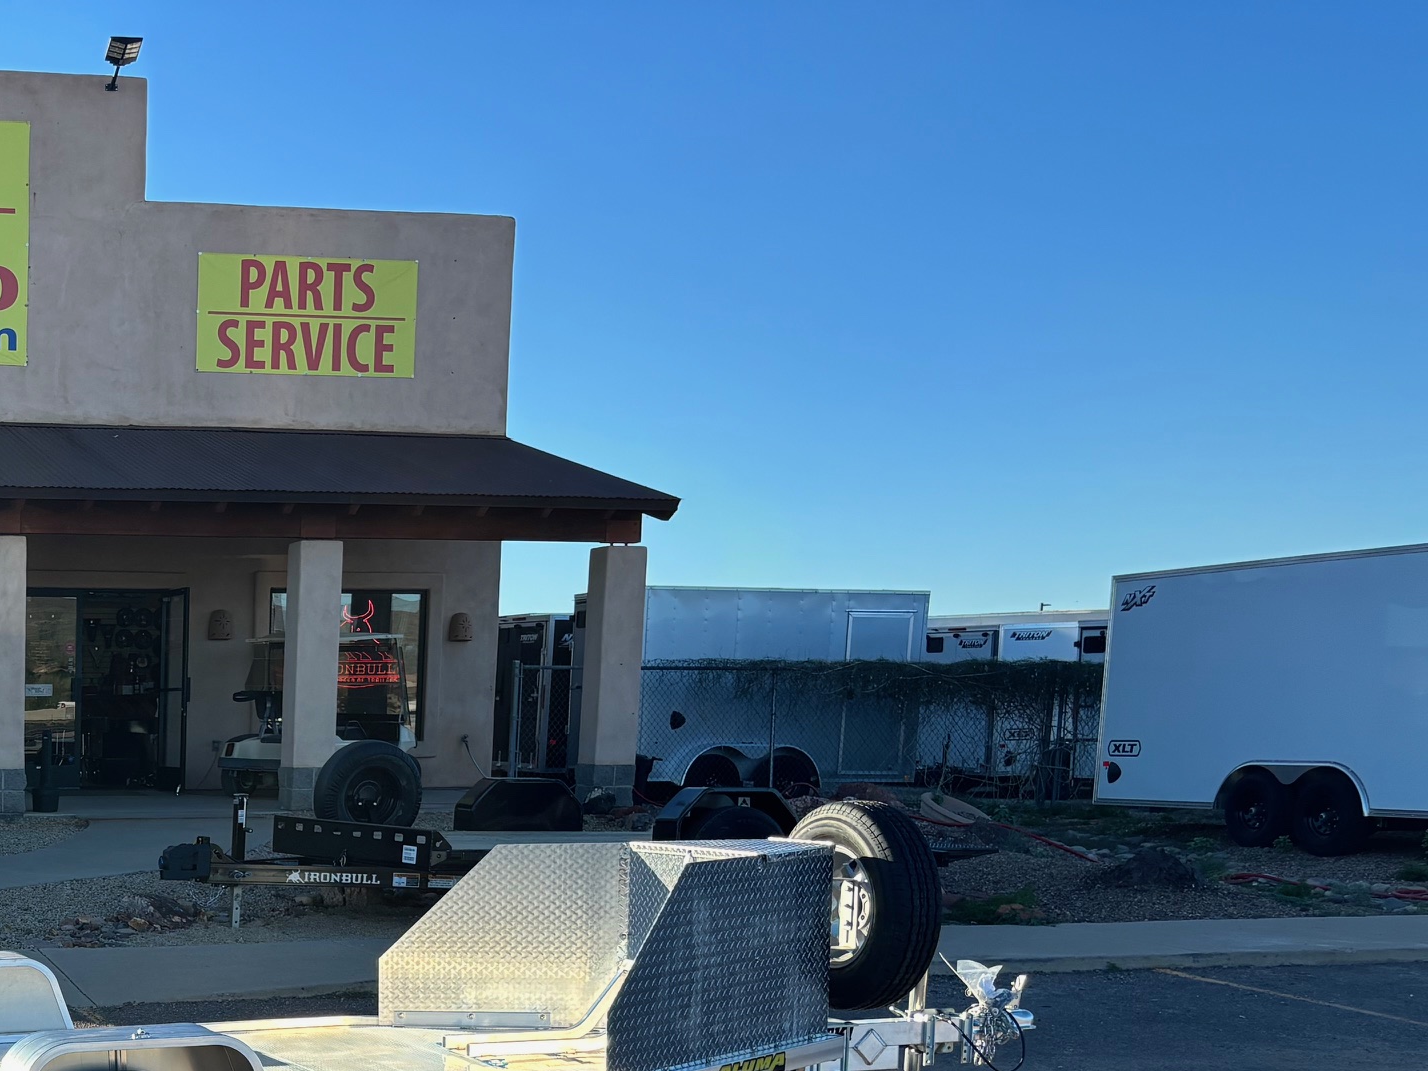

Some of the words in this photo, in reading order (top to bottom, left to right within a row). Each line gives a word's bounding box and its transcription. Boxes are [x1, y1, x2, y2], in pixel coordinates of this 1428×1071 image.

[239, 258, 376, 313] PARTS
[216, 318, 396, 374] SERVICE
[1111, 743, 1138, 754] XLT
[304, 872, 381, 885] IRONBULL
